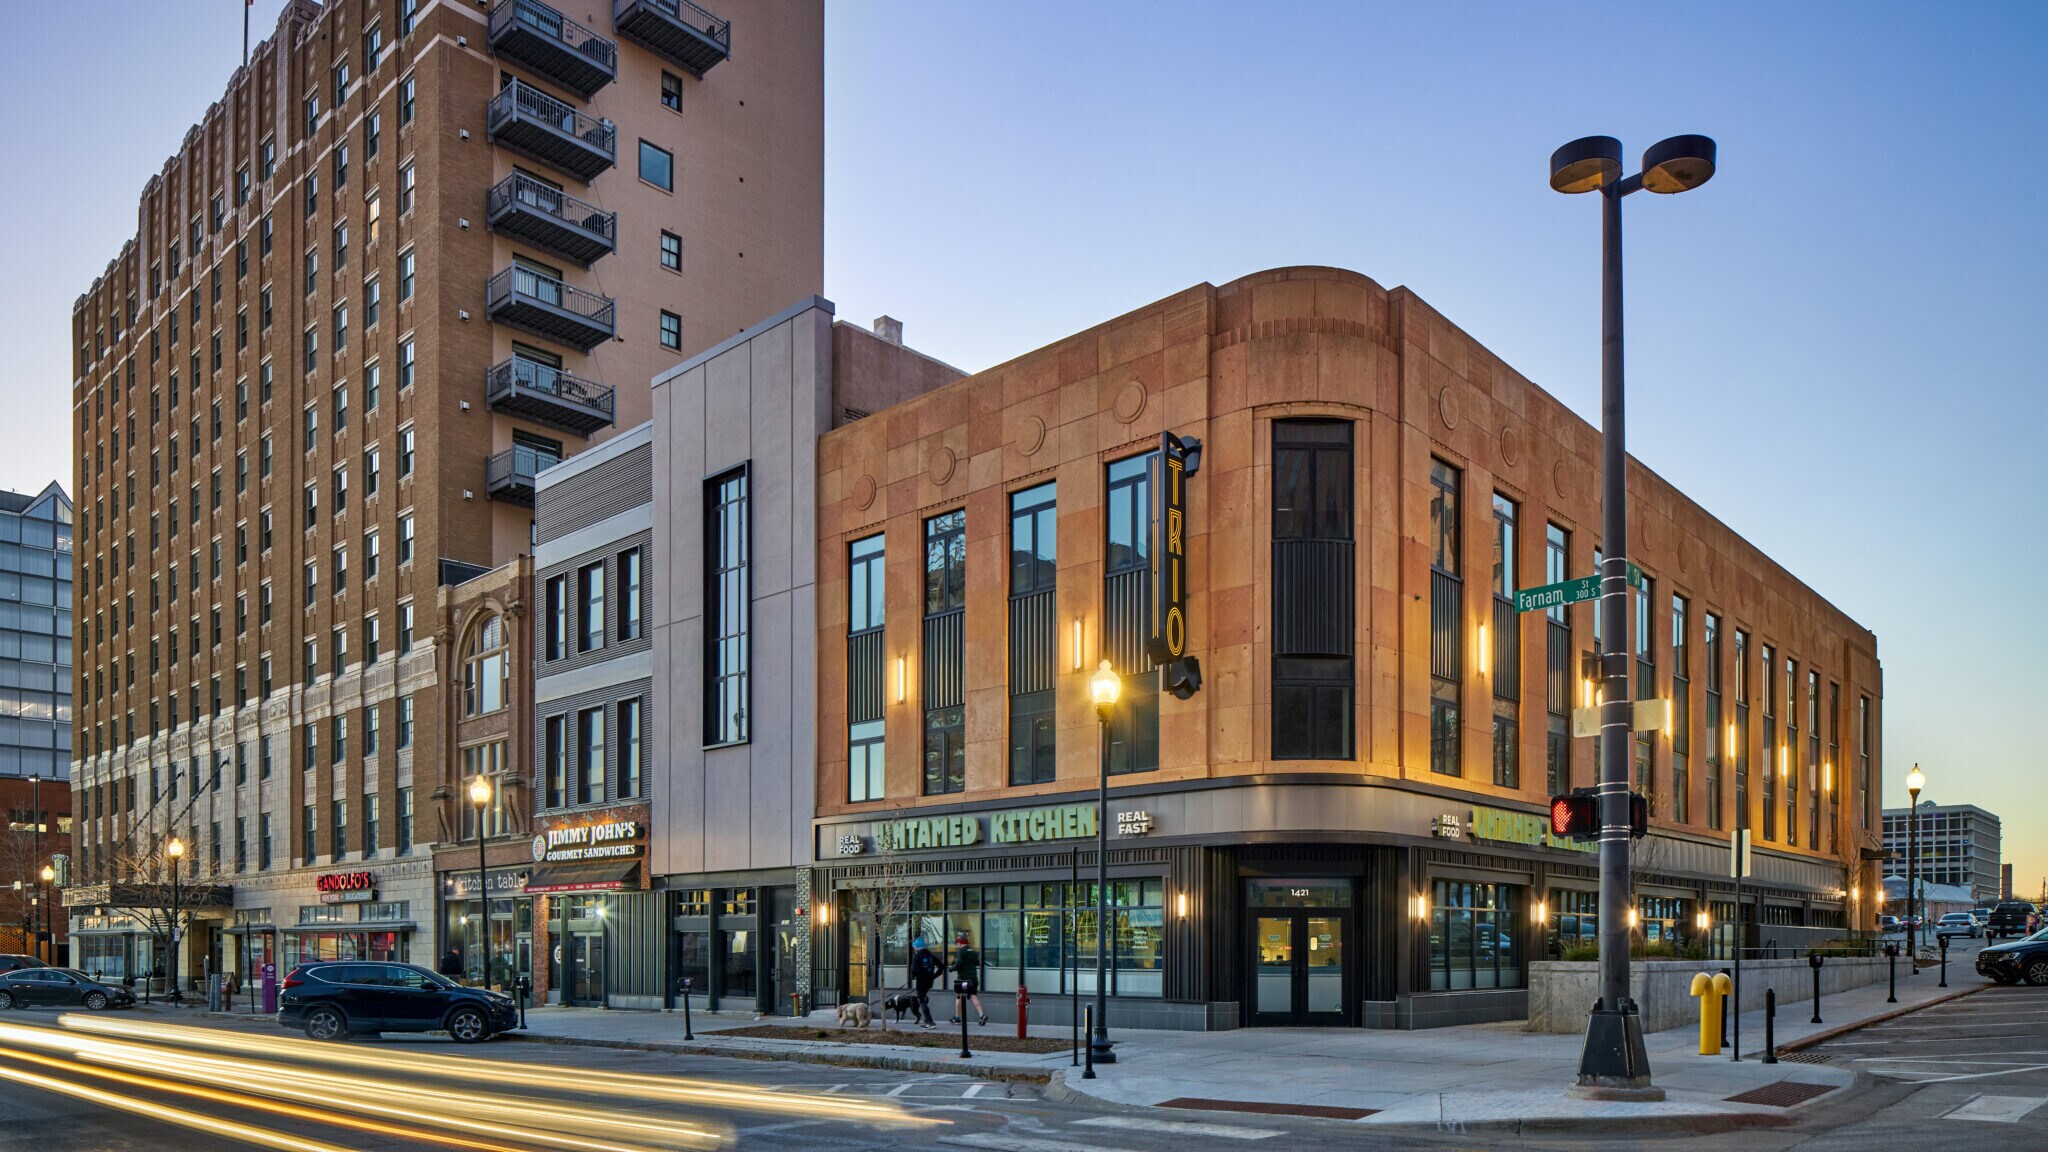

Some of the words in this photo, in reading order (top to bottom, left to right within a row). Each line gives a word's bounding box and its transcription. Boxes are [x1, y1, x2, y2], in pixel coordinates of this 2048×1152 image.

[1166, 458, 1185, 657] TRIO
[1581, 579, 1589, 589] St
[1519, 588, 1564, 610] Farnam
[1576, 590, 1589, 600] 300
[1591, 587, 1596, 597] S
[1117, 810, 1149, 823] REAL
[1442, 814, 1460, 826] REAL
[878, 815, 978, 850] UNTAMED
[990, 805, 1096, 843] KITCHEN
[1118, 822, 1148, 835] FAST
[1442, 826, 1460, 838] FOOD
[1473, 805, 1542, 846] UNTAMED
[548, 827, 589, 850] JIMMY
[590, 821, 636, 845] JOHN'S
[839, 835, 860, 845] REAL
[546, 849, 583, 861] GOURMET
[583, 844, 636, 859] SANDWICHES
[839, 845, 860, 854] FOOD
[317, 872, 370, 892] GANDOLFO'S
[457, 875, 494, 892] kitchn
[497, 872, 526, 889] table
[1290, 888, 1310, 897] 1421
